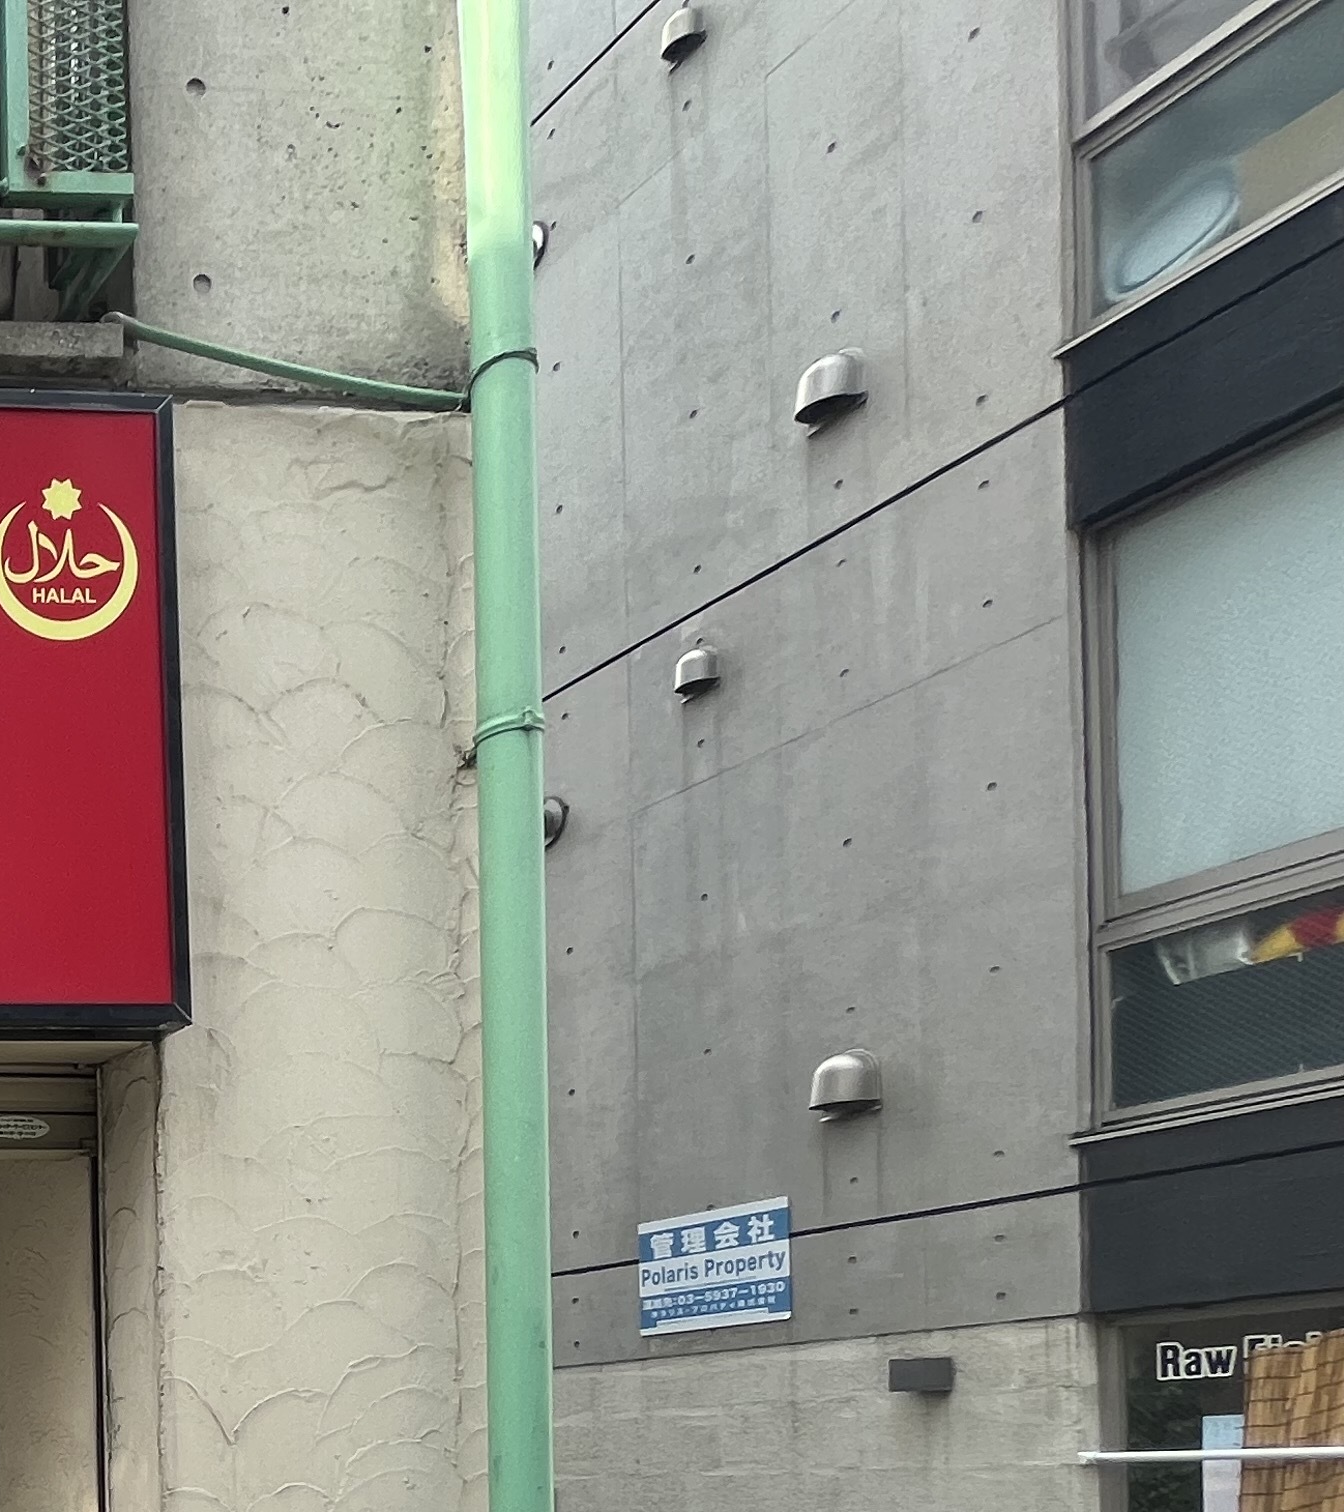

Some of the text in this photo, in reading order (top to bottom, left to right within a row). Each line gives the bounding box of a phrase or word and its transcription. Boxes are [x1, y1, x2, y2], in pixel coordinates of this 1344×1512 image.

[4, 520, 121, 584] حلال
[32, 587, 97, 604] HALAL
[650, 1214, 775, 1260] 管理会社
[641, 1250, 786, 1288] Polaris Property
[1156, 1341, 1238, 1381] Raw
